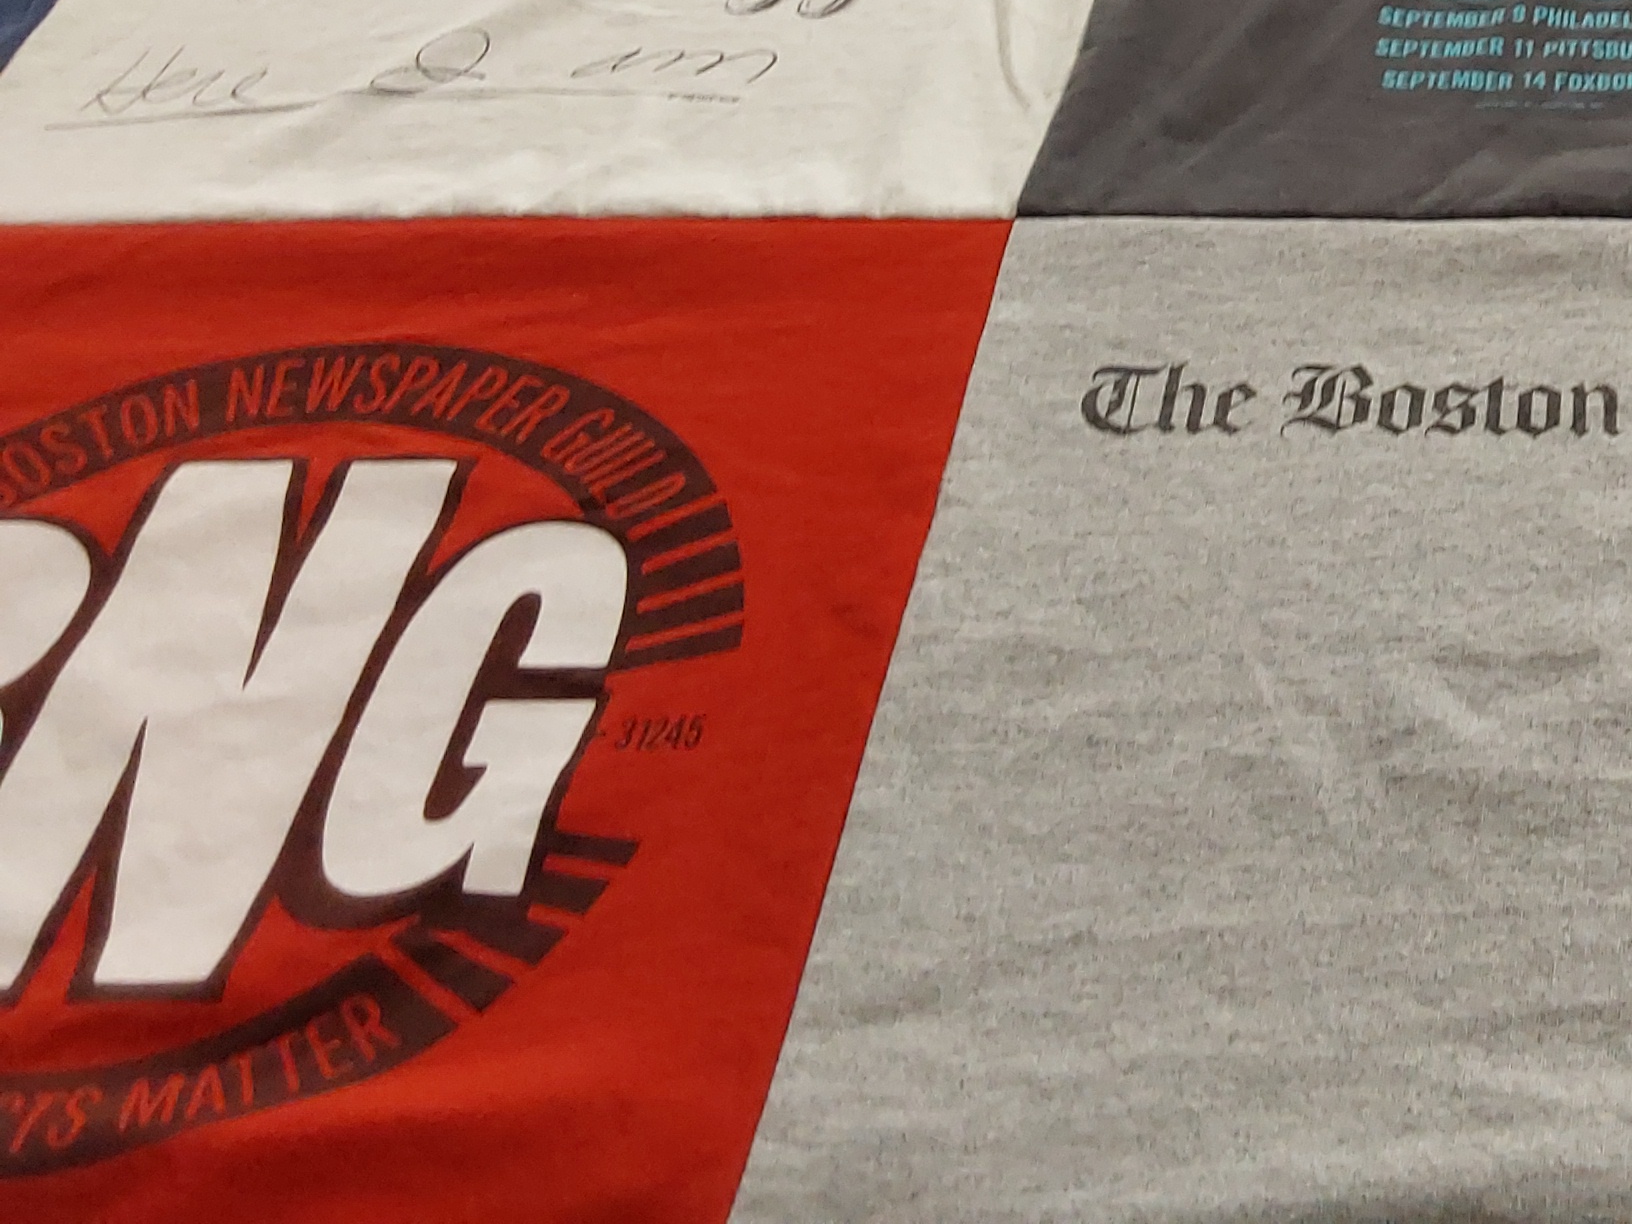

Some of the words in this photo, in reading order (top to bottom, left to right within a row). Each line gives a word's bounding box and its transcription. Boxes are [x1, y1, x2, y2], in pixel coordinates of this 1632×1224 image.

[1377, 6, 1505, 29] SEPTEMBER
[1375, 37, 1504, 58] SEPTEMBER
[1515, 38, 1534, 58] 11
[75, 43, 270, 113] Here
[1382, 69, 1513, 90] SEPTEMBER
[1523, 69, 1546, 90] 14
[1080, 361, 1257, 436] The
[1279, 362, 1623, 438] Boston
[0, 378, 200, 512] OSTON
[226, 356, 570, 444] NEWSPAPER
[540, 407, 687, 522] GUILD
[613, 714, 707, 751] 31245
[116, 994, 402, 1136] MATTER
